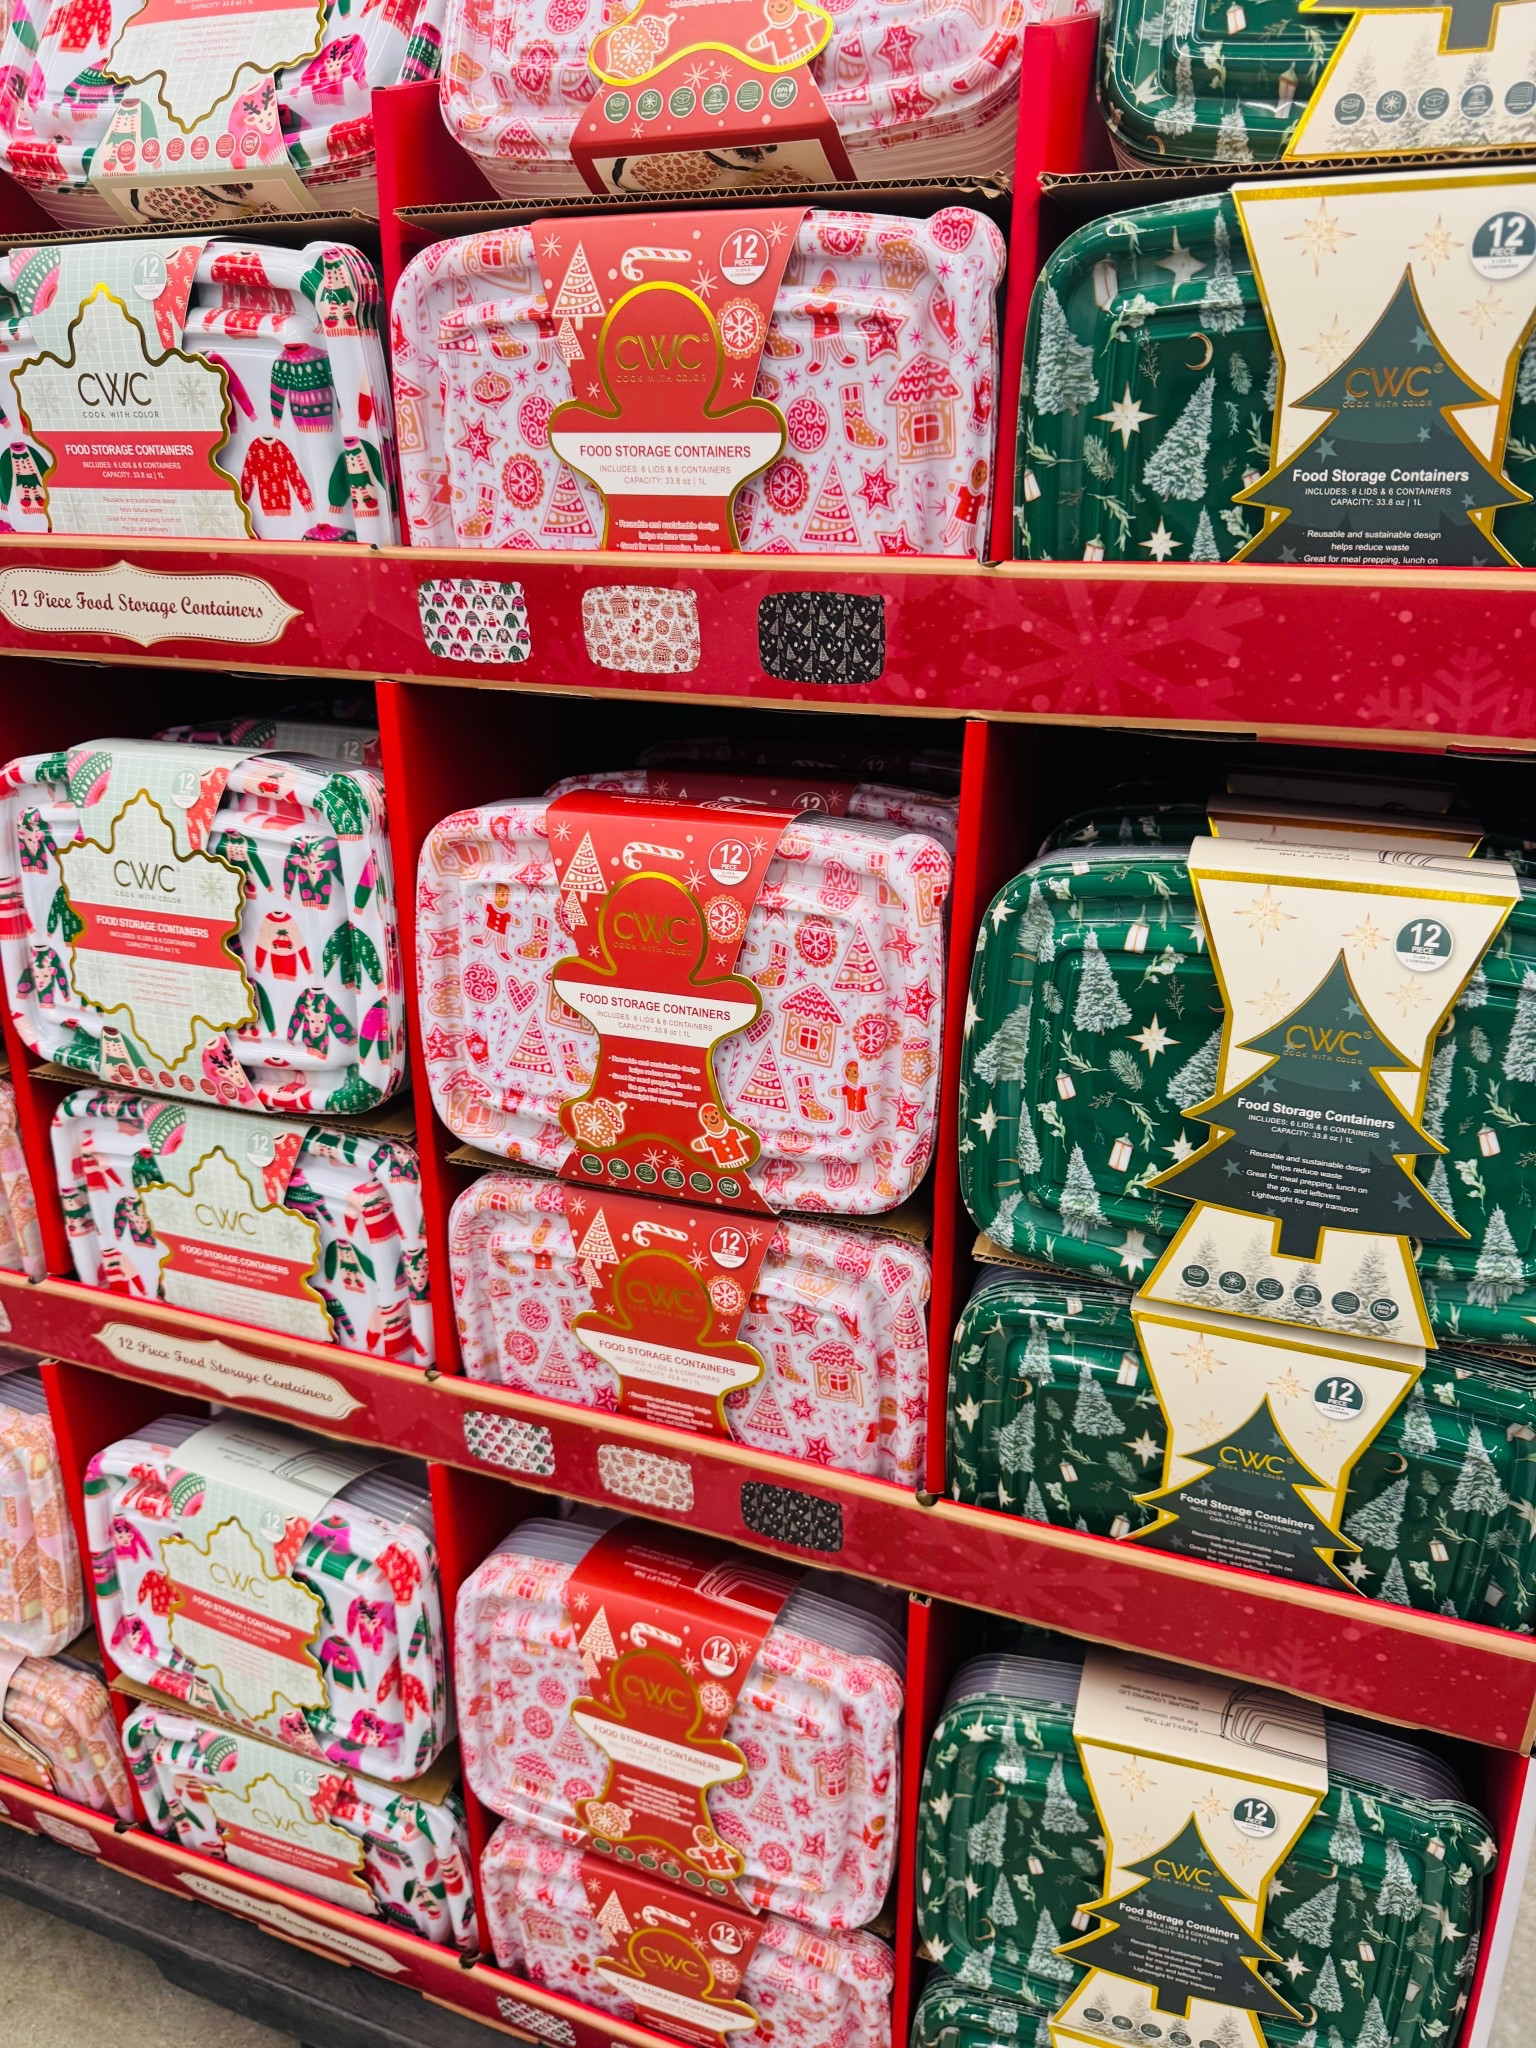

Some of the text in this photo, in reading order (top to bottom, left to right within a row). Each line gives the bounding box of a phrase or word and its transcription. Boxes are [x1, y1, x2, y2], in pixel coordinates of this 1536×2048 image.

[1489, 216, 1526, 247] 12
[732, 234, 759, 259] 12
[1490, 247, 1516, 256] PIECE
[140, 257, 159, 278] 12
[65, 444, 193, 456] FOOD STORAGE CONTAINERS
[580, 445, 750, 458] FOOD STORAGE CONTAINERS
[600, 465, 639, 473] INCLUDES:
[682, 466, 731, 474] CONTAINERS
[1293, 469, 1469, 484] Food Storage Containers
[1307, 530, 1345, 538] Reusable
[1413, 531, 1441, 540] design
[1332, 543, 1353, 551] helps
[1355, 543, 1383, 551] reduce
[1328, 555, 1339, 563] for
[12, 590, 263, 618] 12 Piece Food Storage Containers
[343, 742, 359, 757] 12
[180, 772, 194, 790] 12
[800, 795, 820, 810] 12
[720, 844, 742, 864] 12
[97, 915, 209, 938] FOOD STORAGE CONTAINERS
[1411, 923, 1441, 948] 12
[1412, 946, 1434, 954] PIECE
[580, 993, 731, 1020] FOOD STORAGE CONTAINERS
[1283, 1050, 1363, 1065] COOK WITH COLOR
[1237, 1098, 1395, 1129] Food Storage Containers
[1248, 1115, 1288, 1126] INCLUDES:
[1296, 1121, 1314, 1130] LIDS
[1330, 1125, 1380, 1138] CONTAINERS
[1271, 1126, 1310, 1138] CAPACITY:
[1312, 1132, 1327, 1140] 33.8
[252, 1135, 268, 1151] 12
[1250, 1149, 1371, 1173] Reusable and sustainable design
[1246, 1170, 1267, 1179] Great
[1280, 1174, 1298, 1184] meal
[1299, 1177, 1334, 1189] prepping,
[1336, 1183, 1357, 1192] lunch
[1271, 1163, 1342, 1180] helps reduce waste
[1252, 1191, 1293, 1203] Lightweight
[1306, 1200, 1324, 1209] easy
[1325, 1201, 1358, 1214] transport
[1294, 1187, 1308, 1195] and
[1309, 1190, 1341, 1200] leftovers
[720, 1231, 740, 1250] 12
[599, 1340, 736, 1376] FOOD STORAGE CONTAINERS
[119, 1337, 333, 1402] 12 Piece Food Storage Containers
[1326, 1380, 1357, 1401] 12
[266, 1513, 281, 1528] 12
[1180, 1493, 1315, 1530] Food Storage Containers
[711, 1640, 731, 1662] 12
[593, 1725, 721, 1771] FOOD STORAGE CONTAINERS
[299, 1771, 313, 1785] 12
[1244, 1801, 1267, 1822] 12
[1119, 1902, 1240, 1940] Food Storage Containers
[717, 1925, 736, 1942] 12
